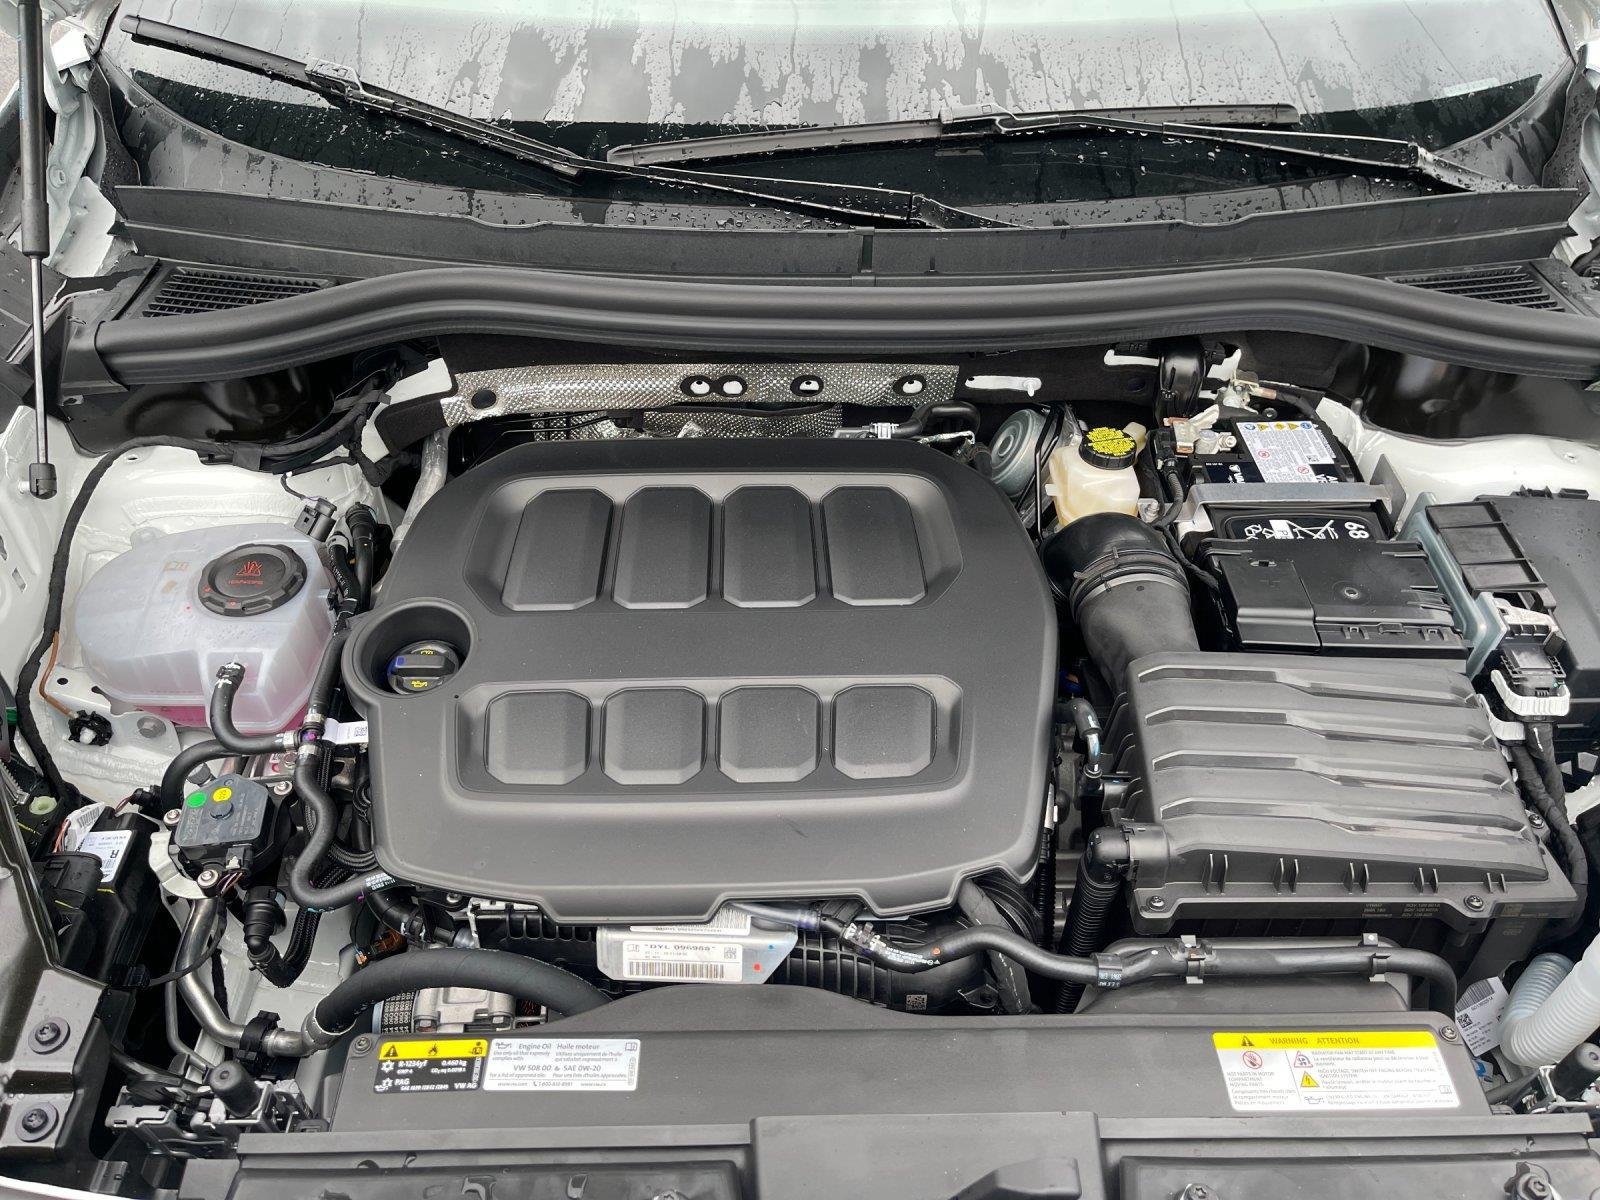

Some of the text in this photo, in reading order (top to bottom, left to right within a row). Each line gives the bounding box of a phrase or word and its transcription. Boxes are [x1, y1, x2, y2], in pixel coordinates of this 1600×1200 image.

[1269, 1037, 1360, 1045] WARNING ATTENTION
[518, 1041, 552, 1051] Engine Oil
[556, 1042, 600, 1050] Huile moteur
